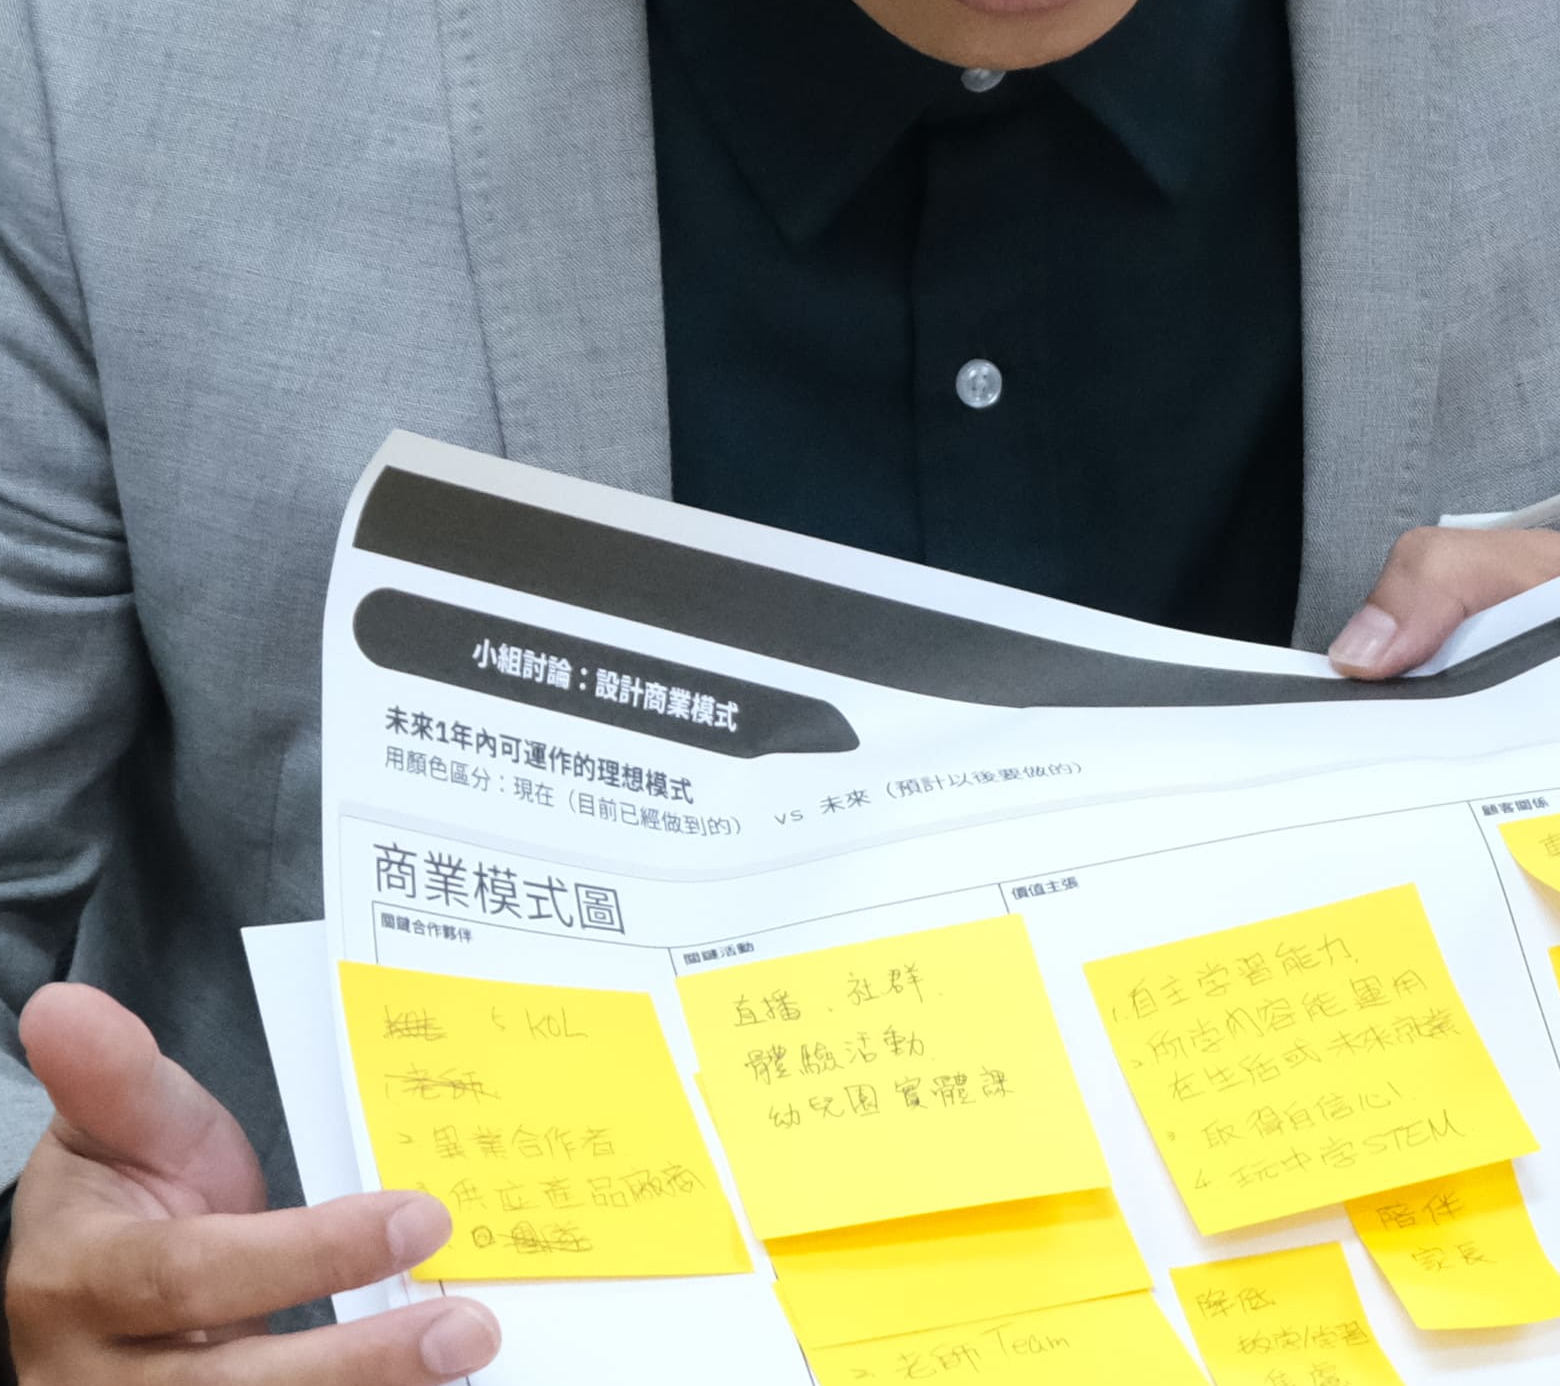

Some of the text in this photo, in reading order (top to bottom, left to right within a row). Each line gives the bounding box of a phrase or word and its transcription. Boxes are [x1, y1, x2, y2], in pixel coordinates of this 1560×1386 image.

[472, 636, 740, 733] 小組討論：設計商業模式
[384, 705, 694, 805] 未來1年內可運作的理想模式
[775, 806, 804, 827] vs
[1482, 796, 1549, 816] 顧客關係
[371, 841, 624, 936] 商業模式圖
[1010, 875, 1079, 903] 價值主張
[380, 912, 473, 943] 關鍵合作夥伴
[683, 941, 755, 965] 關鍵活動
[526, 1006, 589, 1040] KOL
[1375, 1189, 1467, 1232] 陪伴
[1411, 1241, 1498, 1273] 家長
